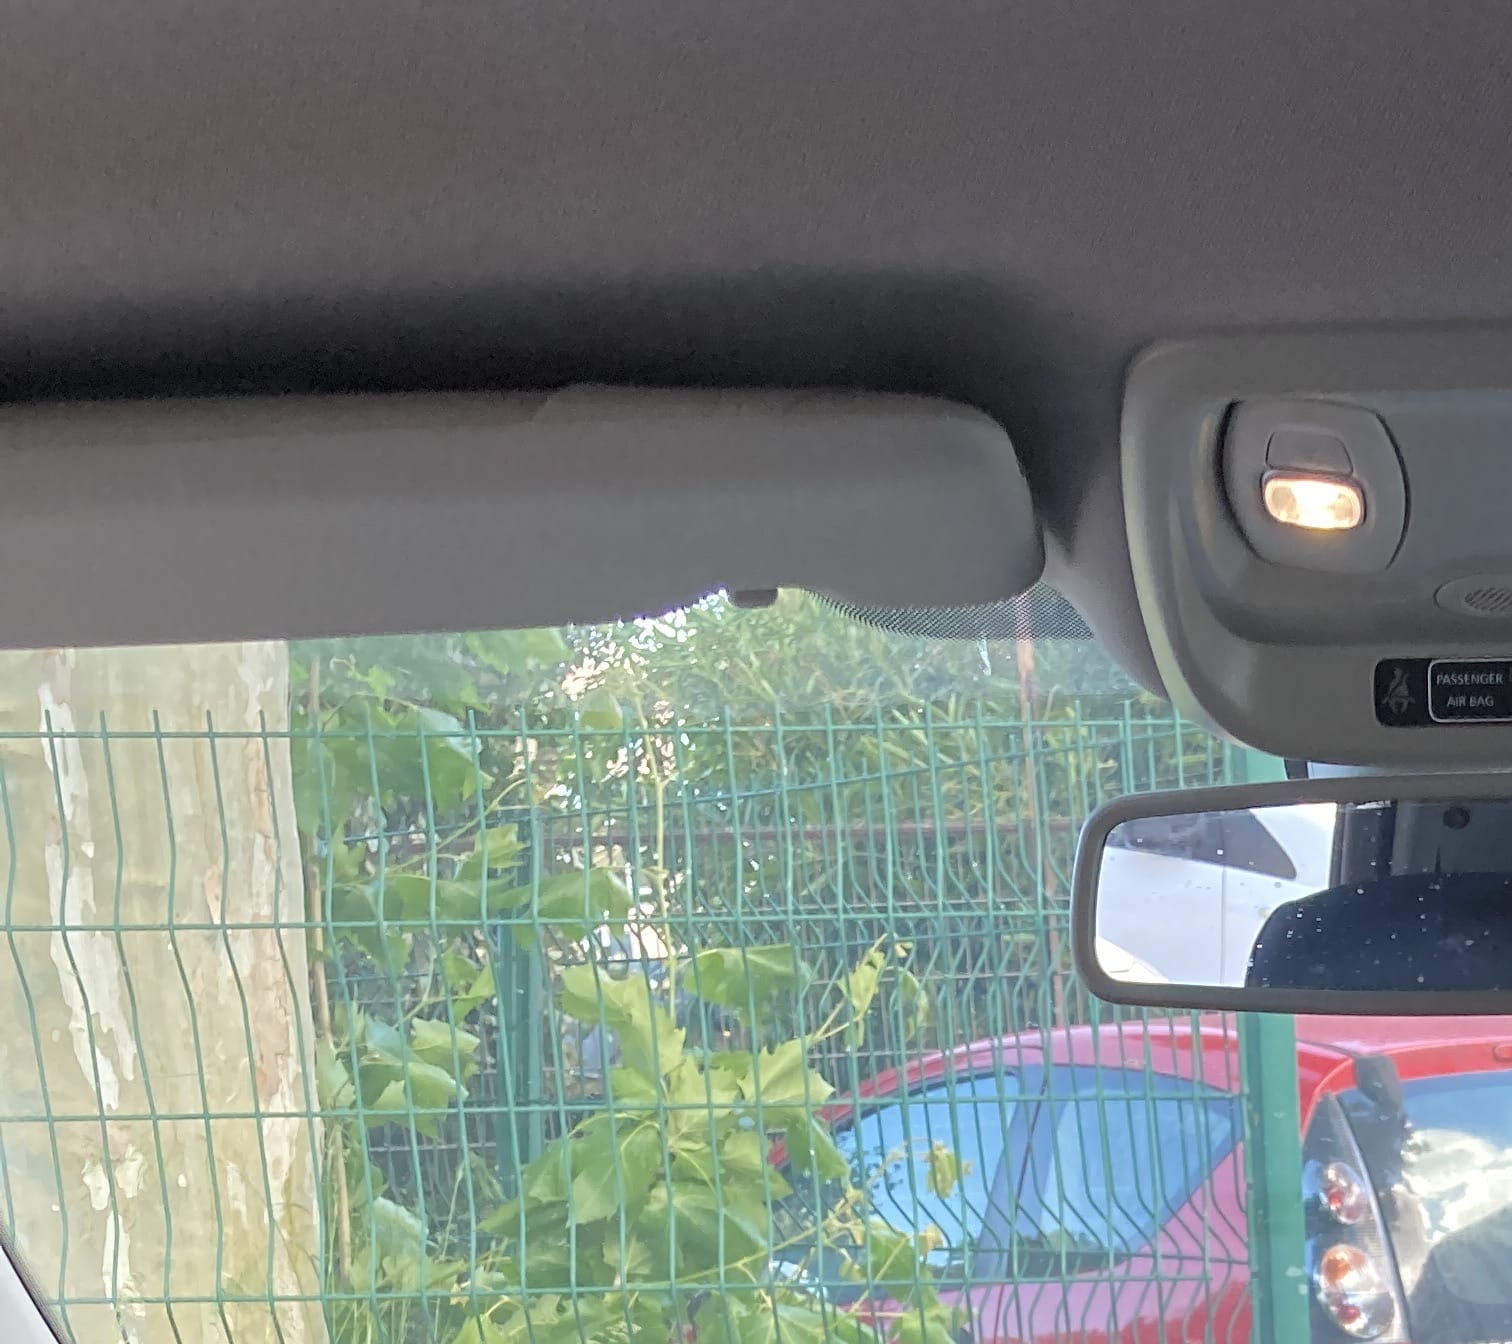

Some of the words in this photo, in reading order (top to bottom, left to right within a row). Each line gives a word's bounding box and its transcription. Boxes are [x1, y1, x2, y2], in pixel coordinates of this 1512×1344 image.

[1436, 673, 1503, 686] PASSENGER
[1447, 696, 1466, 707] AIR
[1469, 696, 1495, 707] BAG
